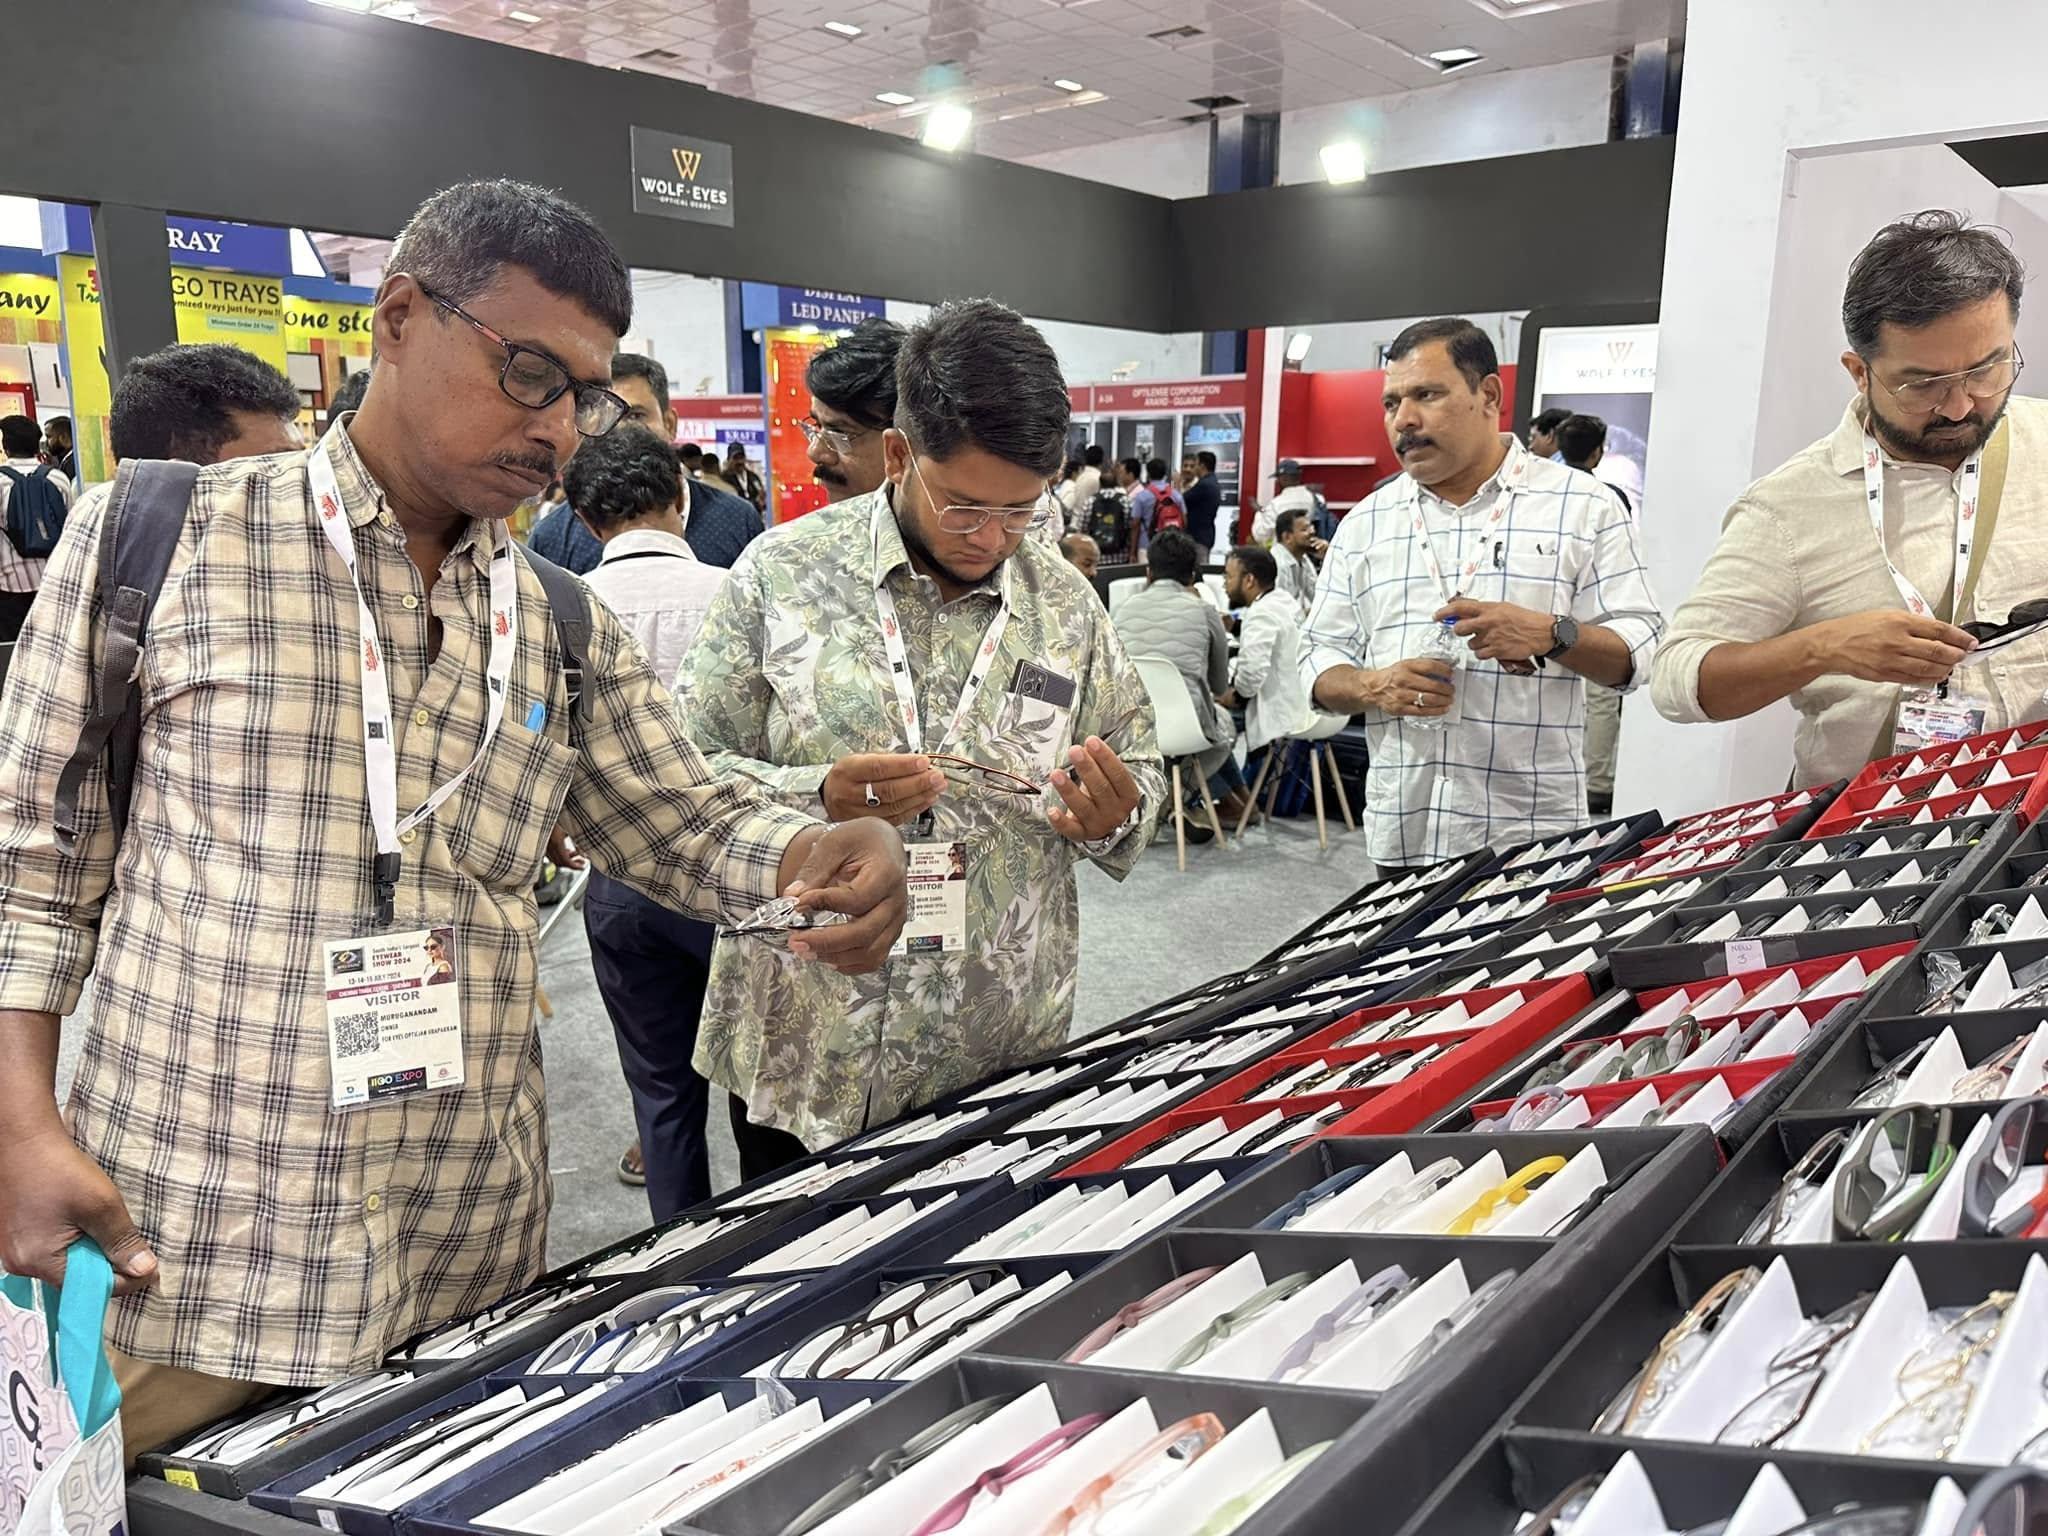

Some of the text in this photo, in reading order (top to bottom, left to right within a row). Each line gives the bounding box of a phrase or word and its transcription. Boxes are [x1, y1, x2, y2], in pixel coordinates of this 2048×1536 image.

[641, 177, 728, 205] WOLF EYES
[208, 279, 280, 305] TRAYS
[204, 303, 225, 313] trays
[227, 304, 243, 314] just
[244, 305, 257, 314] for
[258, 309, 273, 318] you
[791, 302, 821, 320] LED
[284, 310, 329, 328] one
[909, 883, 943, 891] VISITOR
[372, 952, 402, 961] EYEWEAR
[372, 960, 392, 968] SHOW
[364, 990, 421, 1007] VISITOR
[380, 1007, 438, 1021] MURUGANANDAM
[395, 1070, 424, 1082] EXPO
